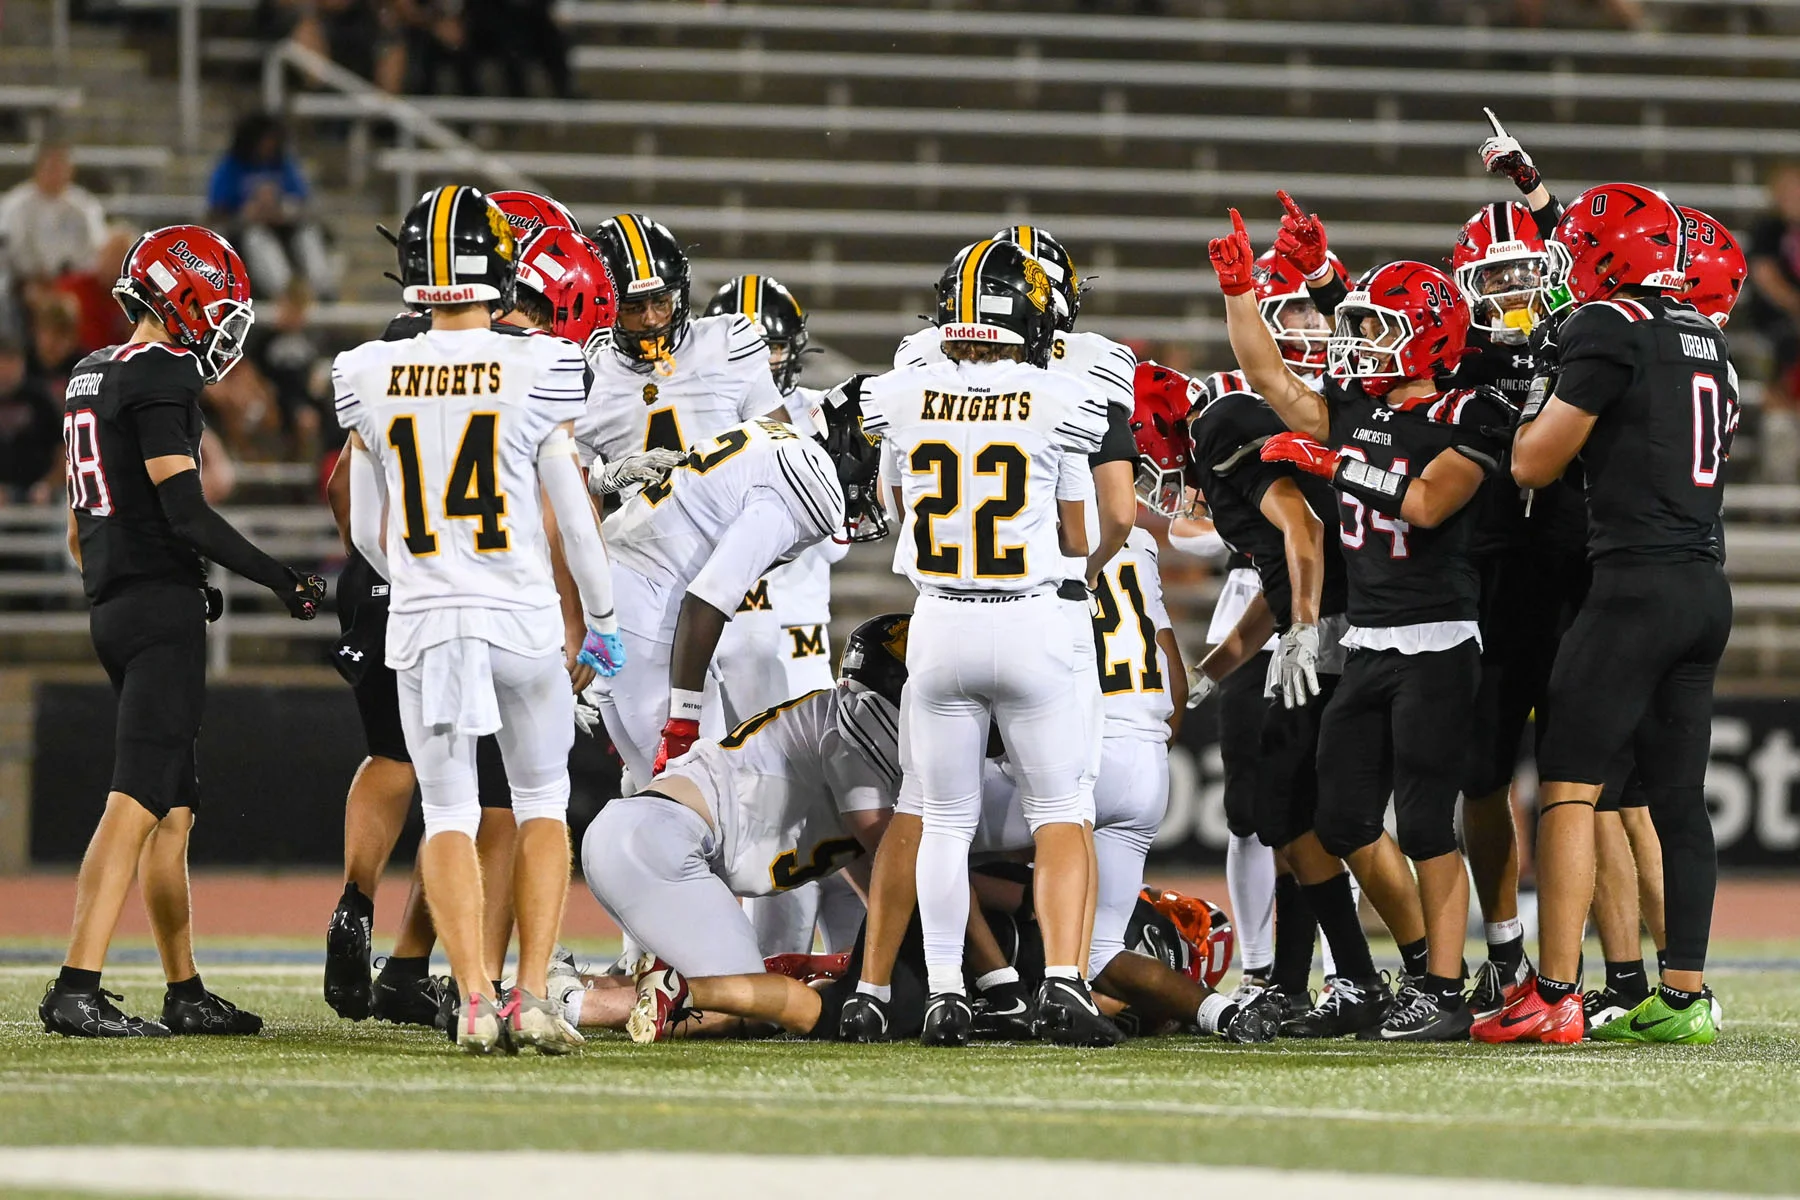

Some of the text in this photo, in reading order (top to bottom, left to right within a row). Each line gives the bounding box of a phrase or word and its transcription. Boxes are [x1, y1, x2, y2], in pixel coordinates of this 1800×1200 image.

[1591, 194, 1608, 216] 0
[1687, 218, 1715, 245] 23
[1490, 244, 1523, 254] Riddell
[167, 240, 224, 290] Legends
[417, 288, 475, 301] Riddell
[632, 280, 660, 290] Riddell
[1421, 281, 1454, 308] 34
[945, 327, 998, 339] Riddell
[1679, 333, 1719, 361] URBAN
[387, 362, 500, 397] KNIGHTS
[967, 386, 991, 394] Riddell
[921, 389, 1031, 422] KNIGHTS
[1353, 427, 1392, 446] LANCASTER
[1692, 372, 1720, 487] 0
[387, 411, 512, 557] 14
[909, 440, 1031, 579] 22
[787, 624, 826, 659] M
[1093, 562, 1165, 696] 21
[1661, 984, 1690, 999] ATTLE
